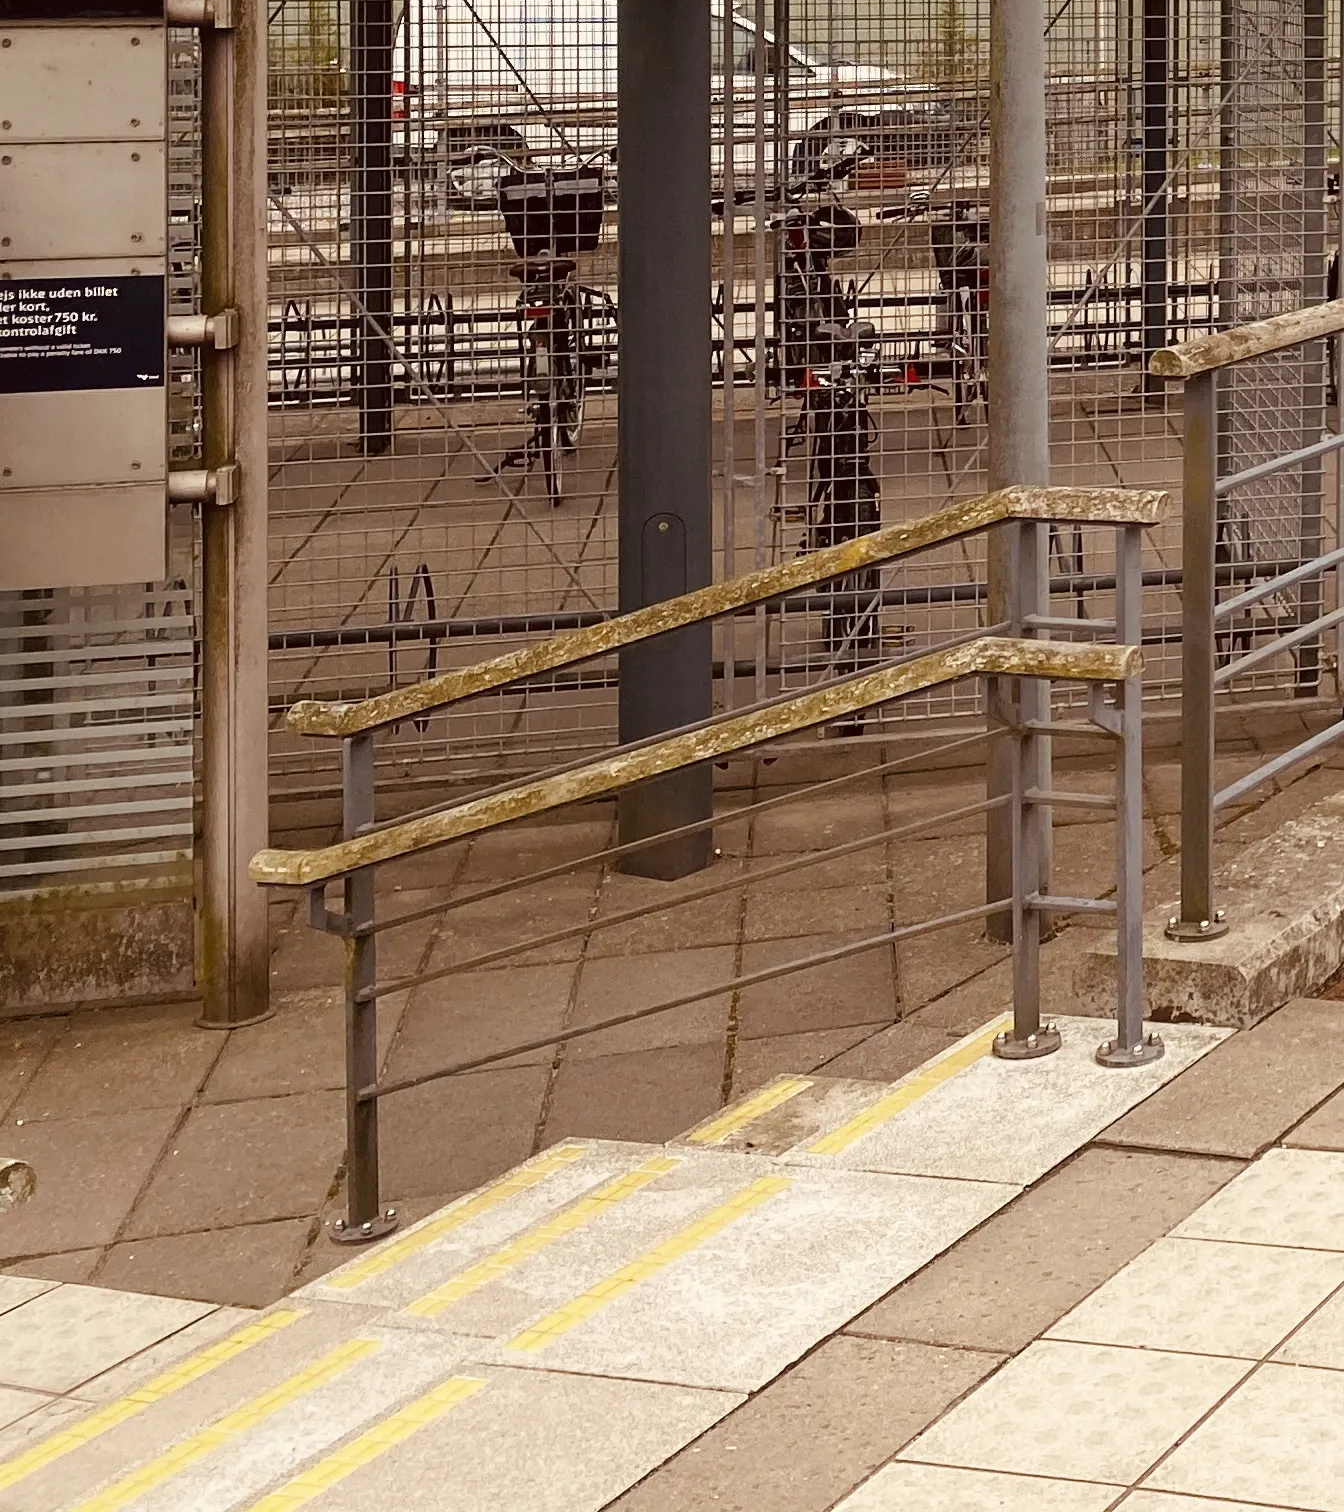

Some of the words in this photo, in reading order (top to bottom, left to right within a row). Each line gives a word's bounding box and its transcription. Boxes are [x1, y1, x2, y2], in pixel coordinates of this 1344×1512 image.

[19, 289, 46, 299] ikke
[49, 288, 81, 298] uden
[85, 286, 118, 298] billet
[19, 301, 50, 311] kort.
[12, 313, 53, 324] koster
[54, 312, 78, 322] 750
[82, 312, 98, 322] kr.
